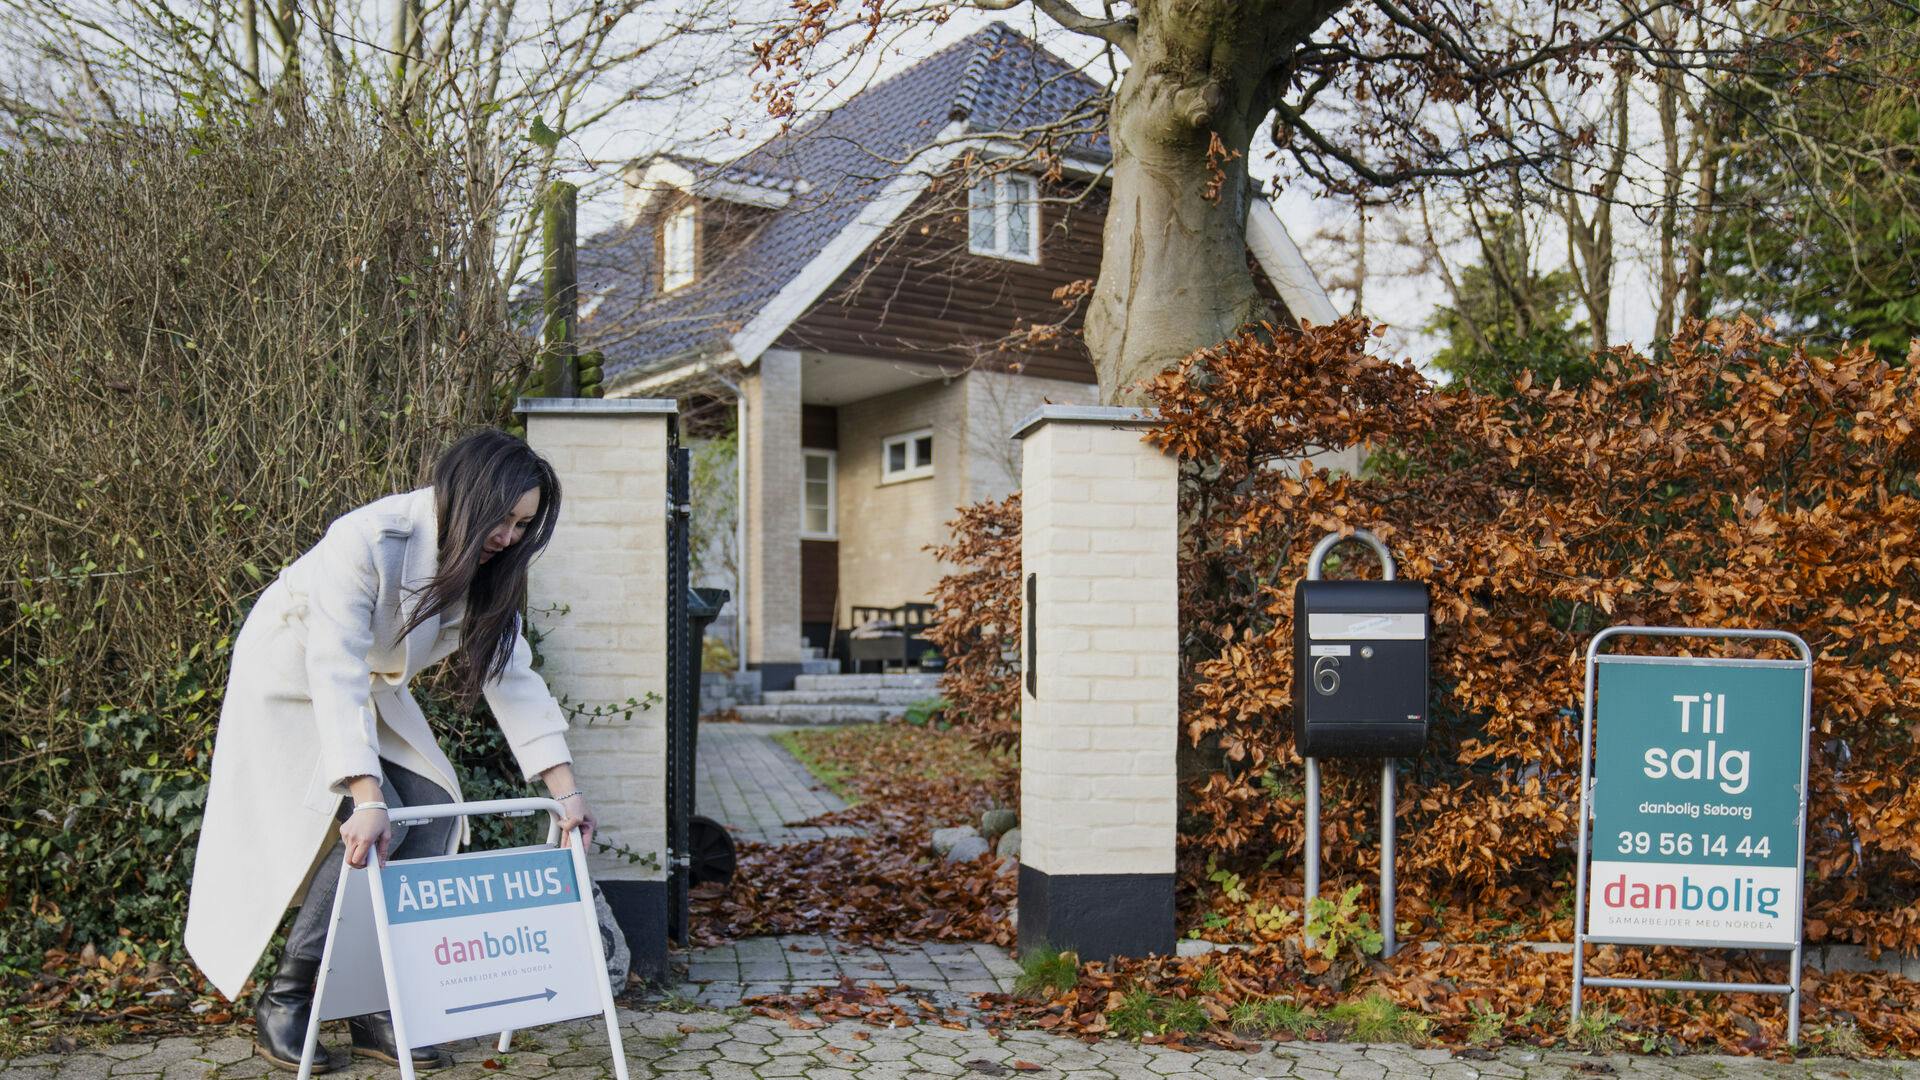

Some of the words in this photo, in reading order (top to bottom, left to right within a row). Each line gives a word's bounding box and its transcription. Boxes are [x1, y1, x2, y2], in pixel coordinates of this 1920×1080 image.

[1313, 655, 1340, 696] 6
[1673, 692, 1725, 734] Til
[1643, 740, 1750, 795] salg
[1639, 801, 1700, 818] danbolig
[1703, 803, 1752, 820] Søborg
[1617, 831, 1651, 855] 39
[1659, 832, 1693, 856] 56
[1701, 834, 1728, 857] 14
[1735, 835, 1771, 859] 44
[397, 874, 495, 913] ÅBENT
[1604, 874, 1781, 919] danbolig
[1608, 916, 1691, 927] SAMARBEJDER
[1696, 919, 1720, 928] MED
[1725, 920, 1773, 929] NORDEA
[434, 925, 550, 966] danbolig
[501, 969, 518, 978] MED
[520, 963, 553, 974] NORDEA
